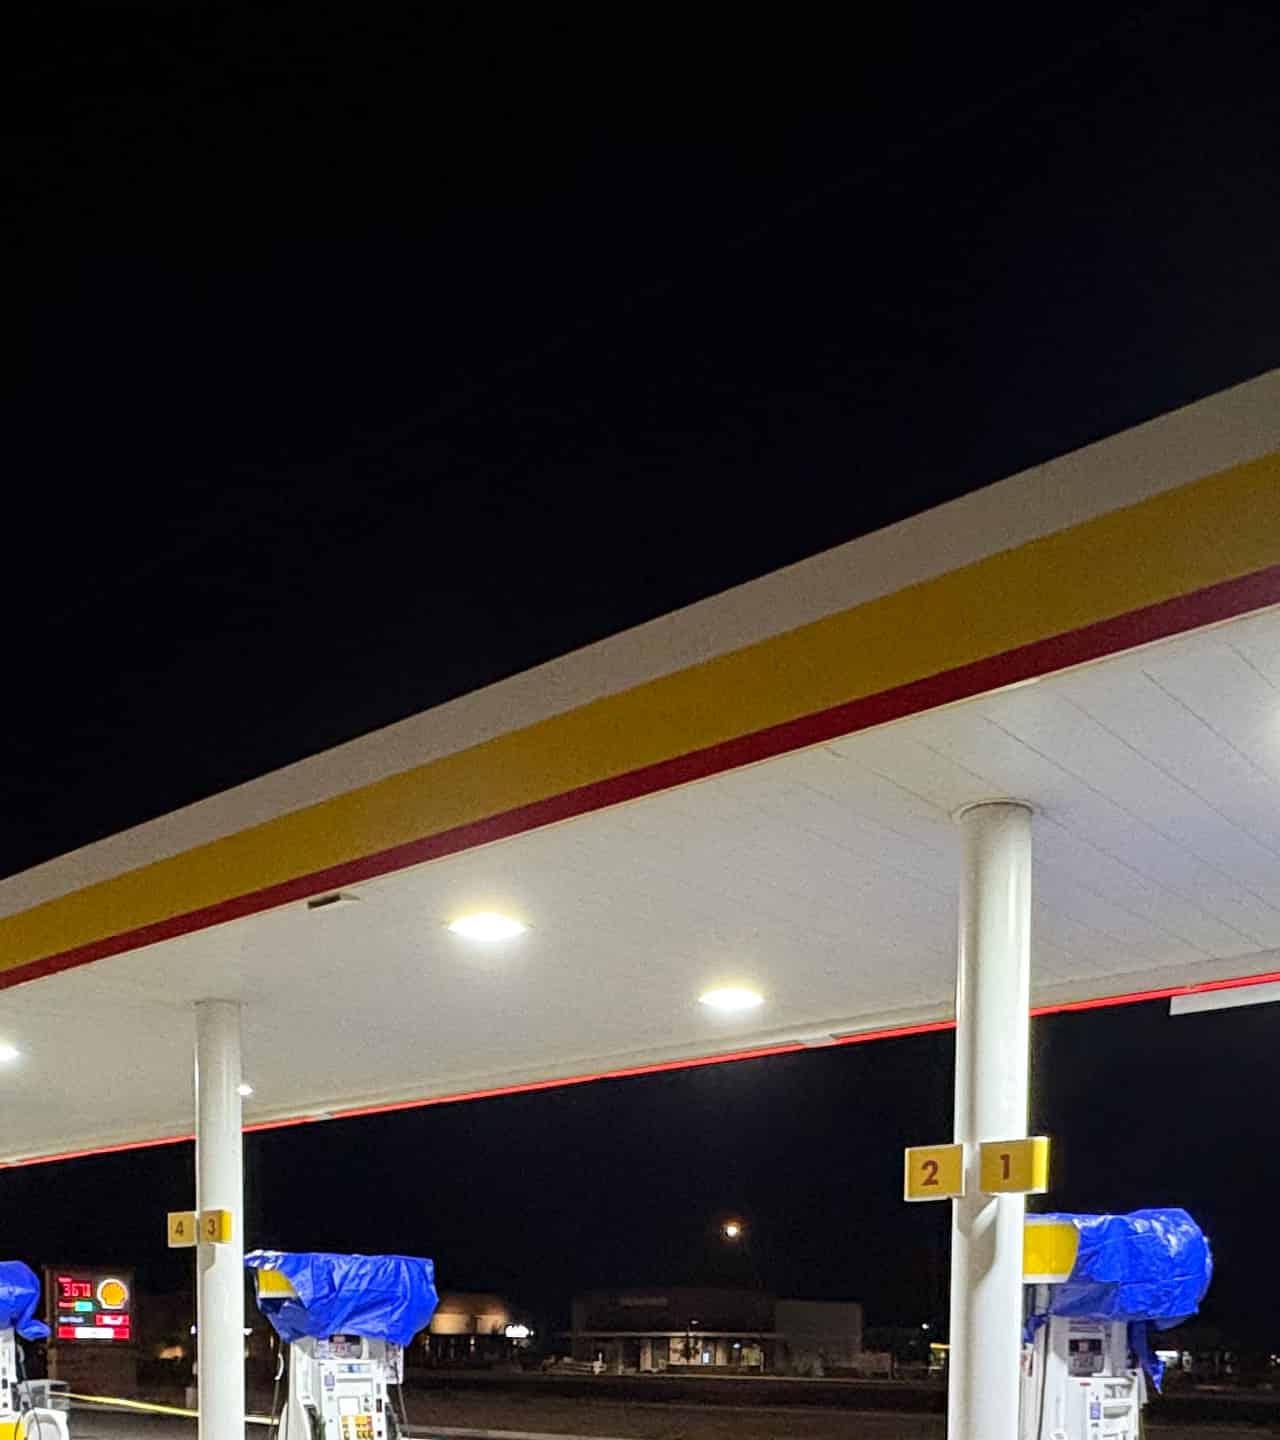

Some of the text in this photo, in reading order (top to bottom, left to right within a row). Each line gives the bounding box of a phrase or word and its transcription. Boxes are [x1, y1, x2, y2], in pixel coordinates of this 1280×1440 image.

[921, 1160, 939, 1185] 2
[999, 1154, 1011, 1180] 1
[175, 1220, 185, 1237] 4
[207, 1218, 216, 1235] 3
